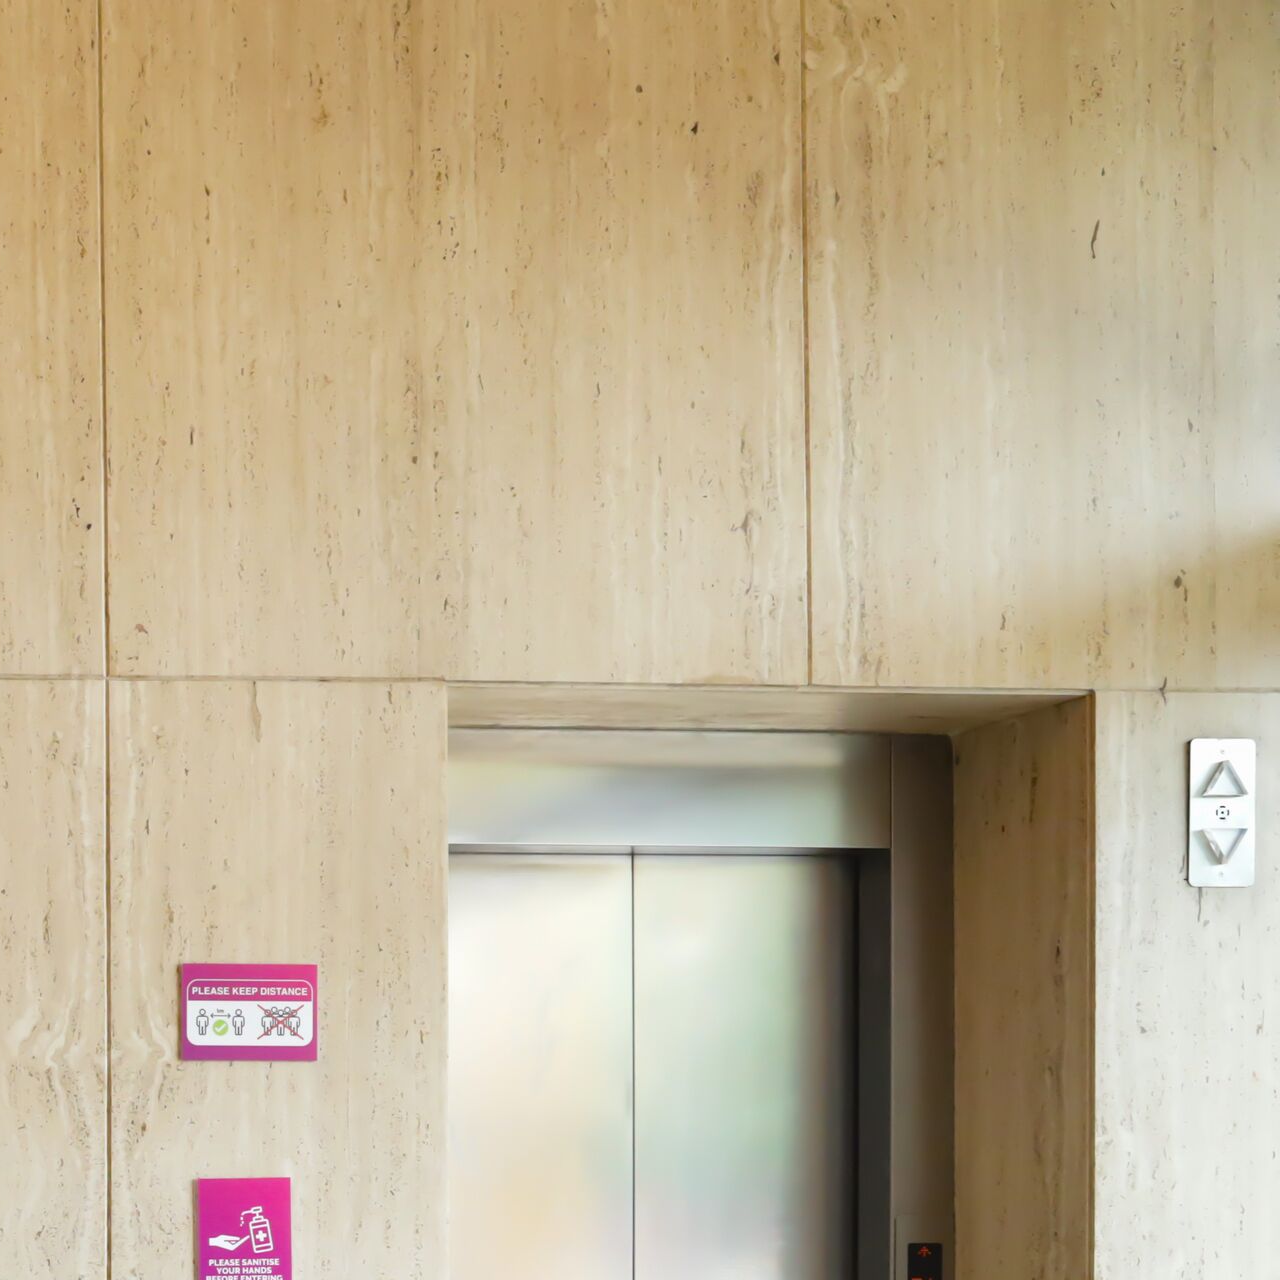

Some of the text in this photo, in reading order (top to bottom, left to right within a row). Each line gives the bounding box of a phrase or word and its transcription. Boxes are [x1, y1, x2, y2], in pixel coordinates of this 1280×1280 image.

[192, 987, 308, 996] PLEASE KEEP DISTANCE
[208, 1258, 281, 1267] PLEASE SANITISE
[215, 1266, 273, 1275] YOUR HANDS
